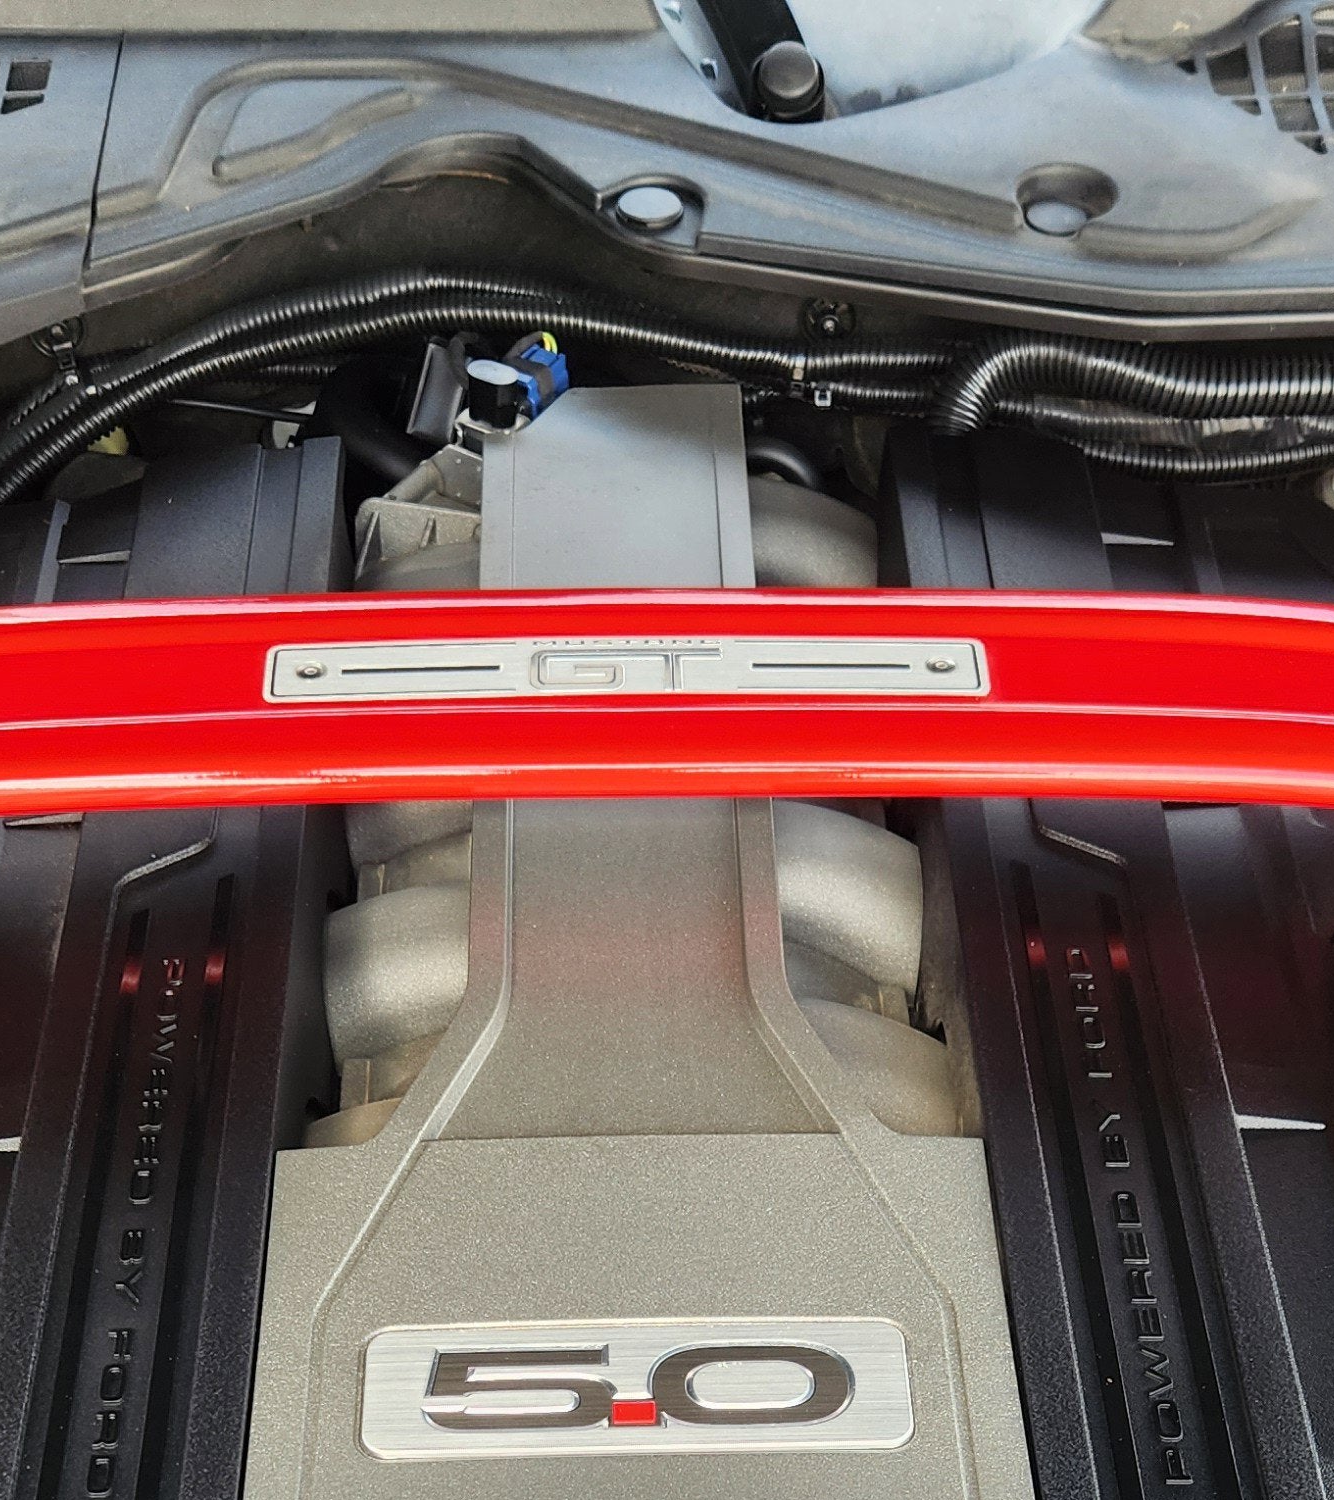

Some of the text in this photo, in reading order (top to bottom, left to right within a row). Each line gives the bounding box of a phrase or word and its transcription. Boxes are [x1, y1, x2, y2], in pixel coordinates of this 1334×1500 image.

[530, 648, 724, 692] GT
[1093, 1101, 1131, 1168] BY
[86, 957, 186, 1498] POWERED BY FORD
[420, 1337, 856, 1431] 5.0
[1113, 1190, 1195, 1485] POWERED
